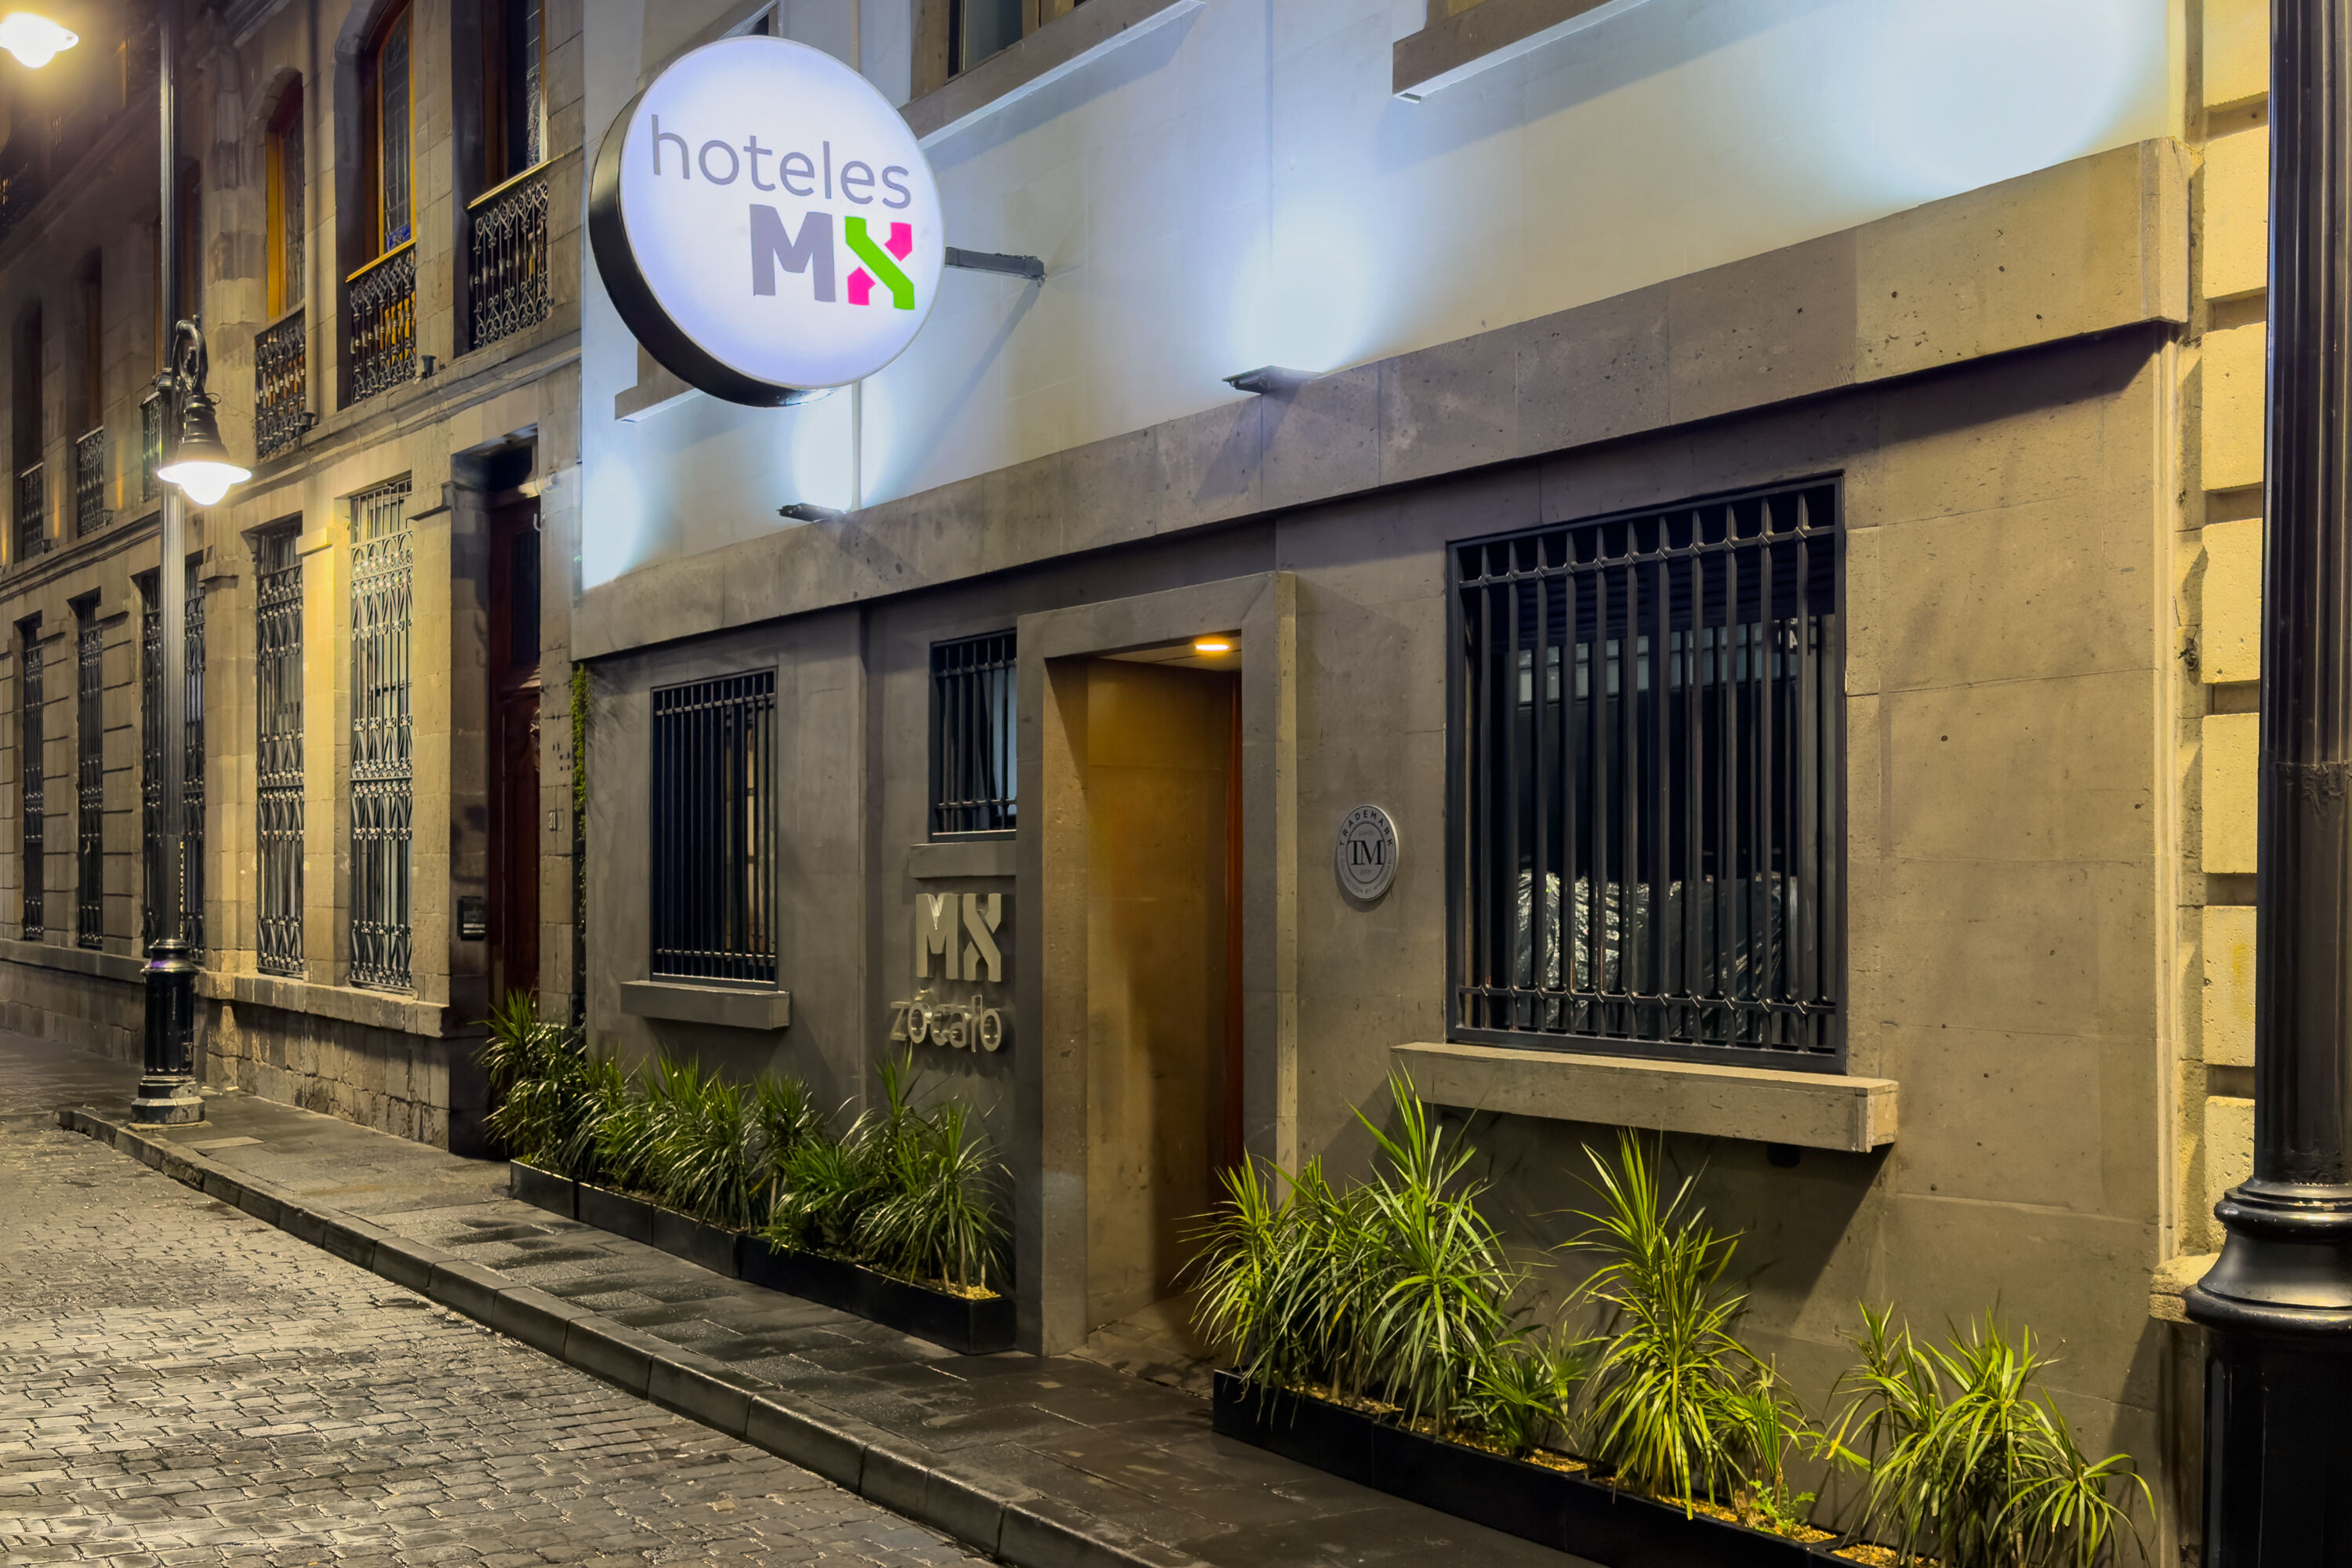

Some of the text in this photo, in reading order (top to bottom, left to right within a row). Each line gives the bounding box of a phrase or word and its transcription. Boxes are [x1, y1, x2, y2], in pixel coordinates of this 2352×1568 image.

[652, 114, 912, 209] hoteles
[750, 204, 916, 310] MX
[1339, 810, 1393, 846] TRADEMARK
[1348, 840, 1384, 866] TM
[916, 893, 1002, 982] MX
